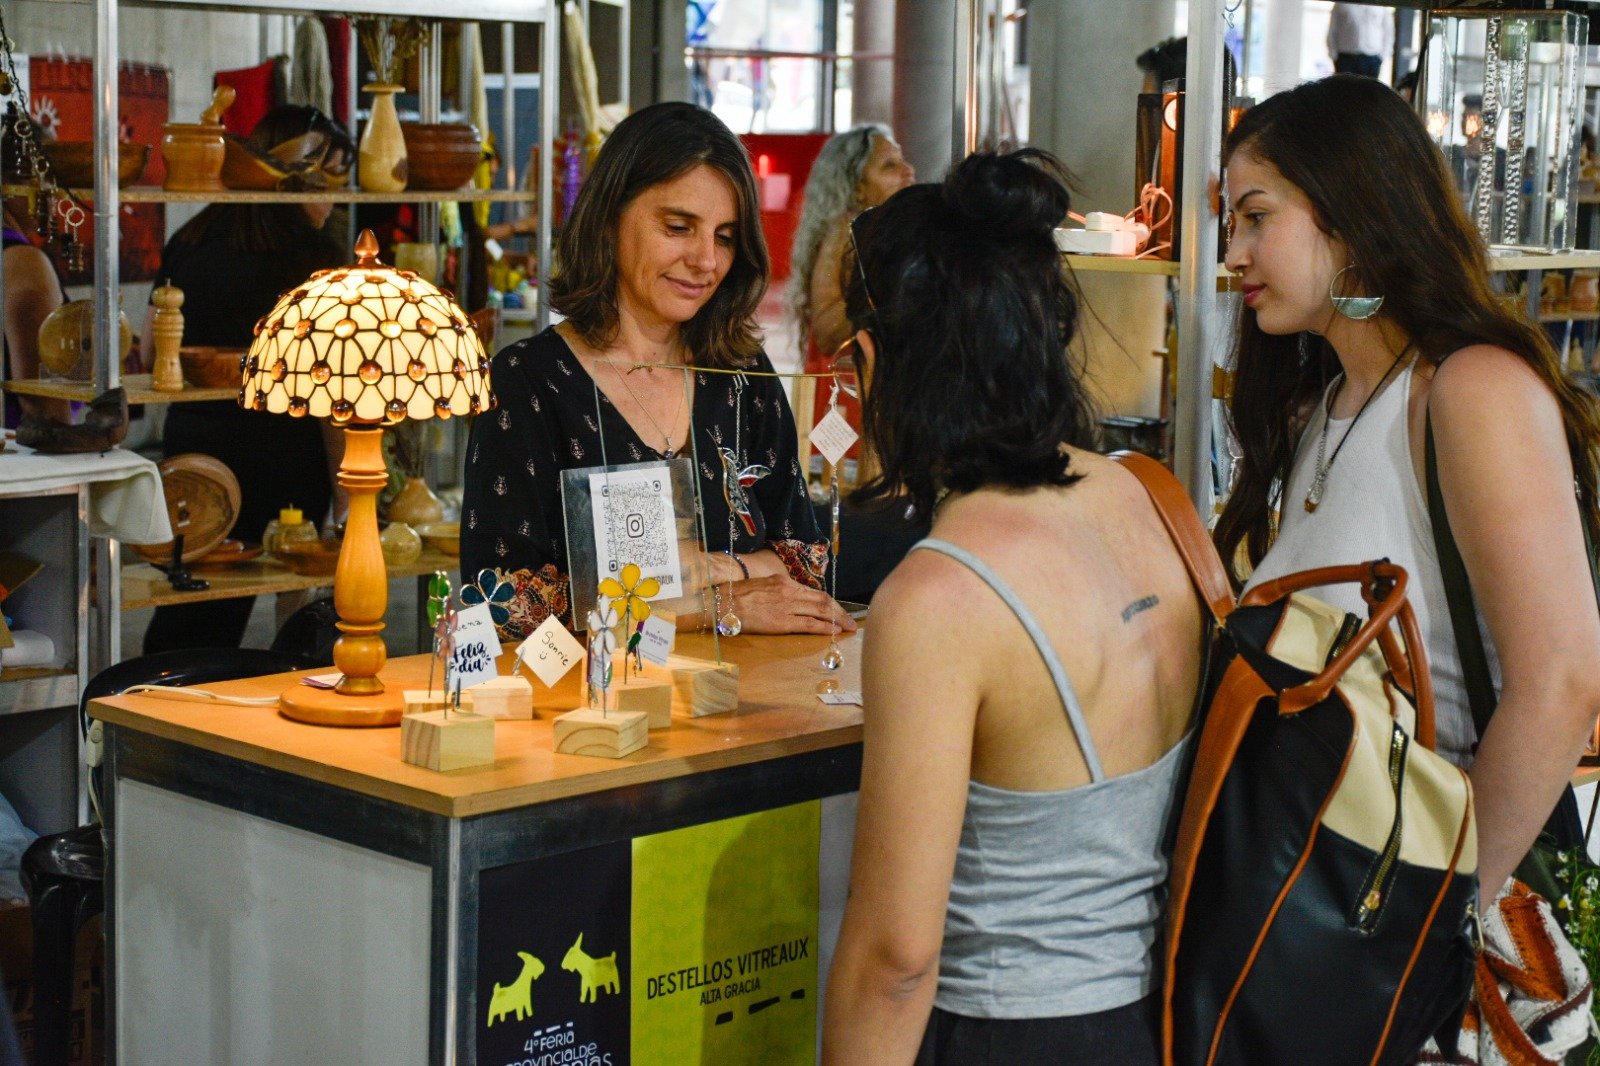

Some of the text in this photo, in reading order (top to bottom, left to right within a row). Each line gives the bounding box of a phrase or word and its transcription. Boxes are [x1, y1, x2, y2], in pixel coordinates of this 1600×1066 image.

[453, 641, 488, 663] Feliz
[647, 936, 809, 1000] DESTELLOS VITREAUX
[699, 977, 761, 1006] ALTA GRACIA
